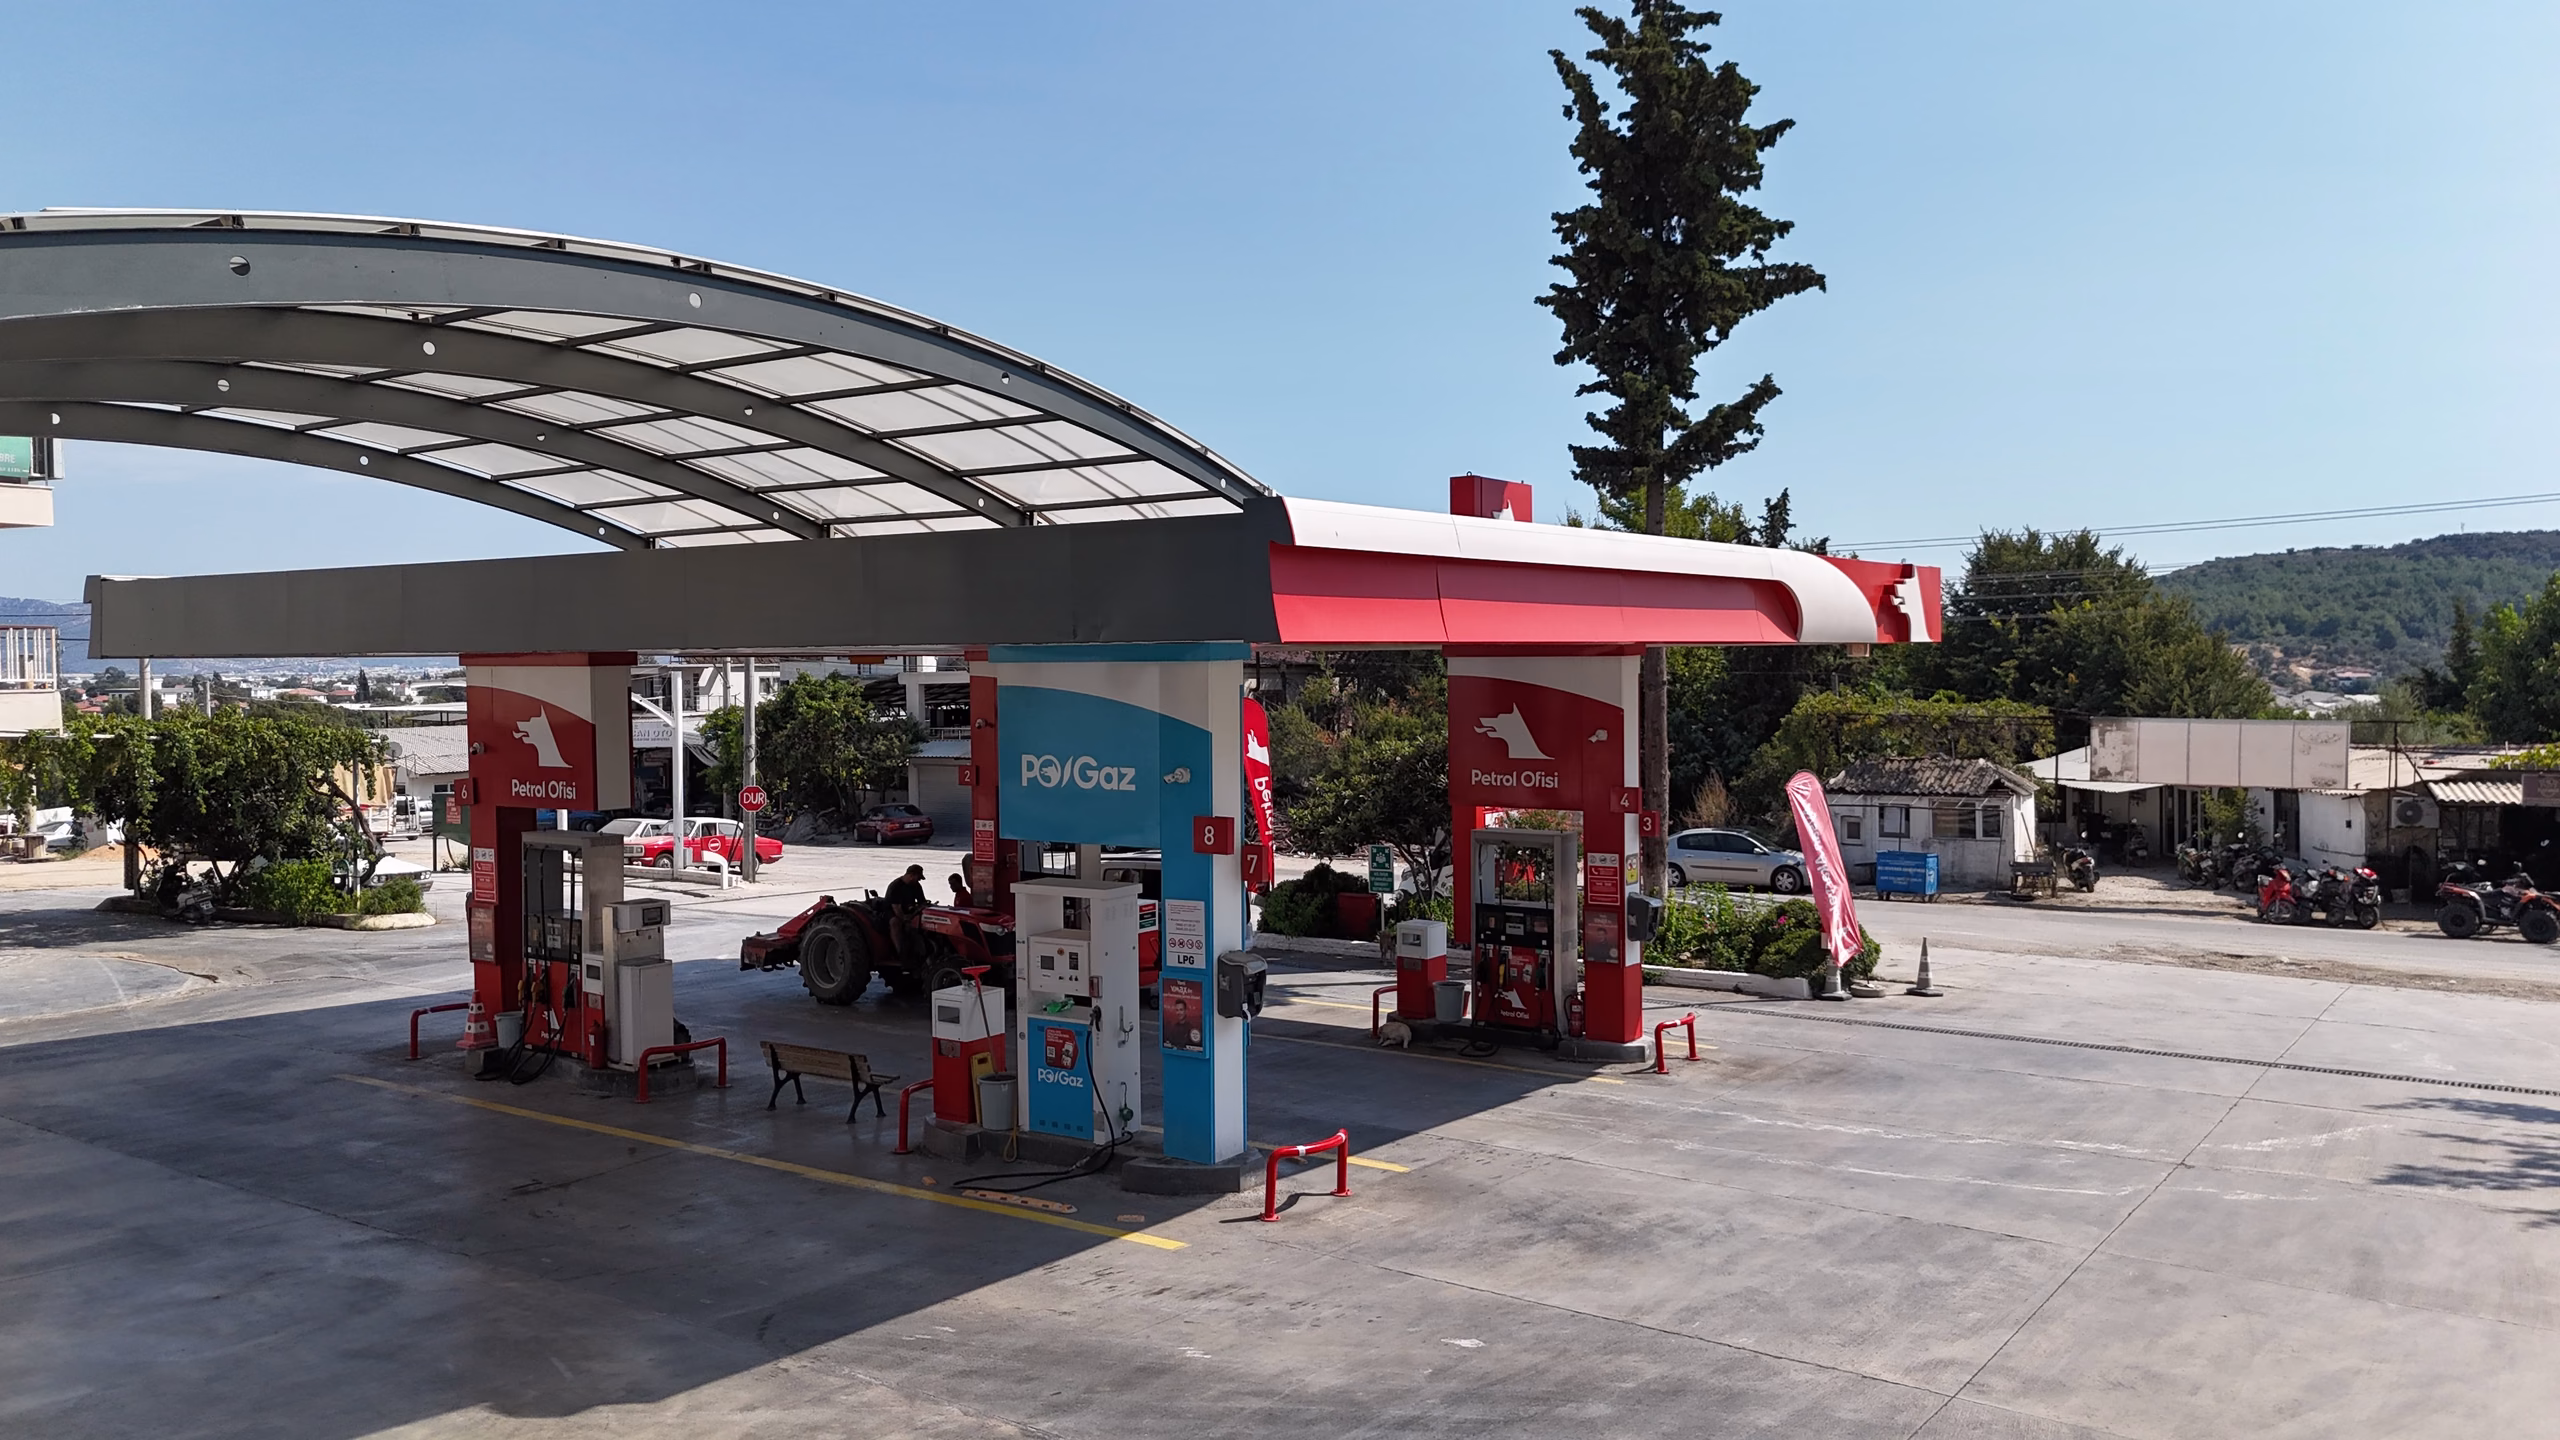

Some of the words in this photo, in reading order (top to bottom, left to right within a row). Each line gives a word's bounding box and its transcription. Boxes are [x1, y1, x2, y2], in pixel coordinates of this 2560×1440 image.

[653, 729, 673, 738] OTO
[964, 770, 971, 782] 2
[1471, 769, 1517, 787] Petrol
[1520, 770, 1559, 788] Ofisi
[461, 784, 468, 799] 6
[511, 779, 546, 798] Petrol
[548, 780, 577, 800] Ofisi
[743, 792, 765, 805] DUR
[1620, 793, 1630, 808] 4
[1643, 816, 1652, 831] 3
[1204, 825, 1215, 846] 8
[1247, 854, 1258, 874] 7
[1177, 954, 1195, 966] LPG
